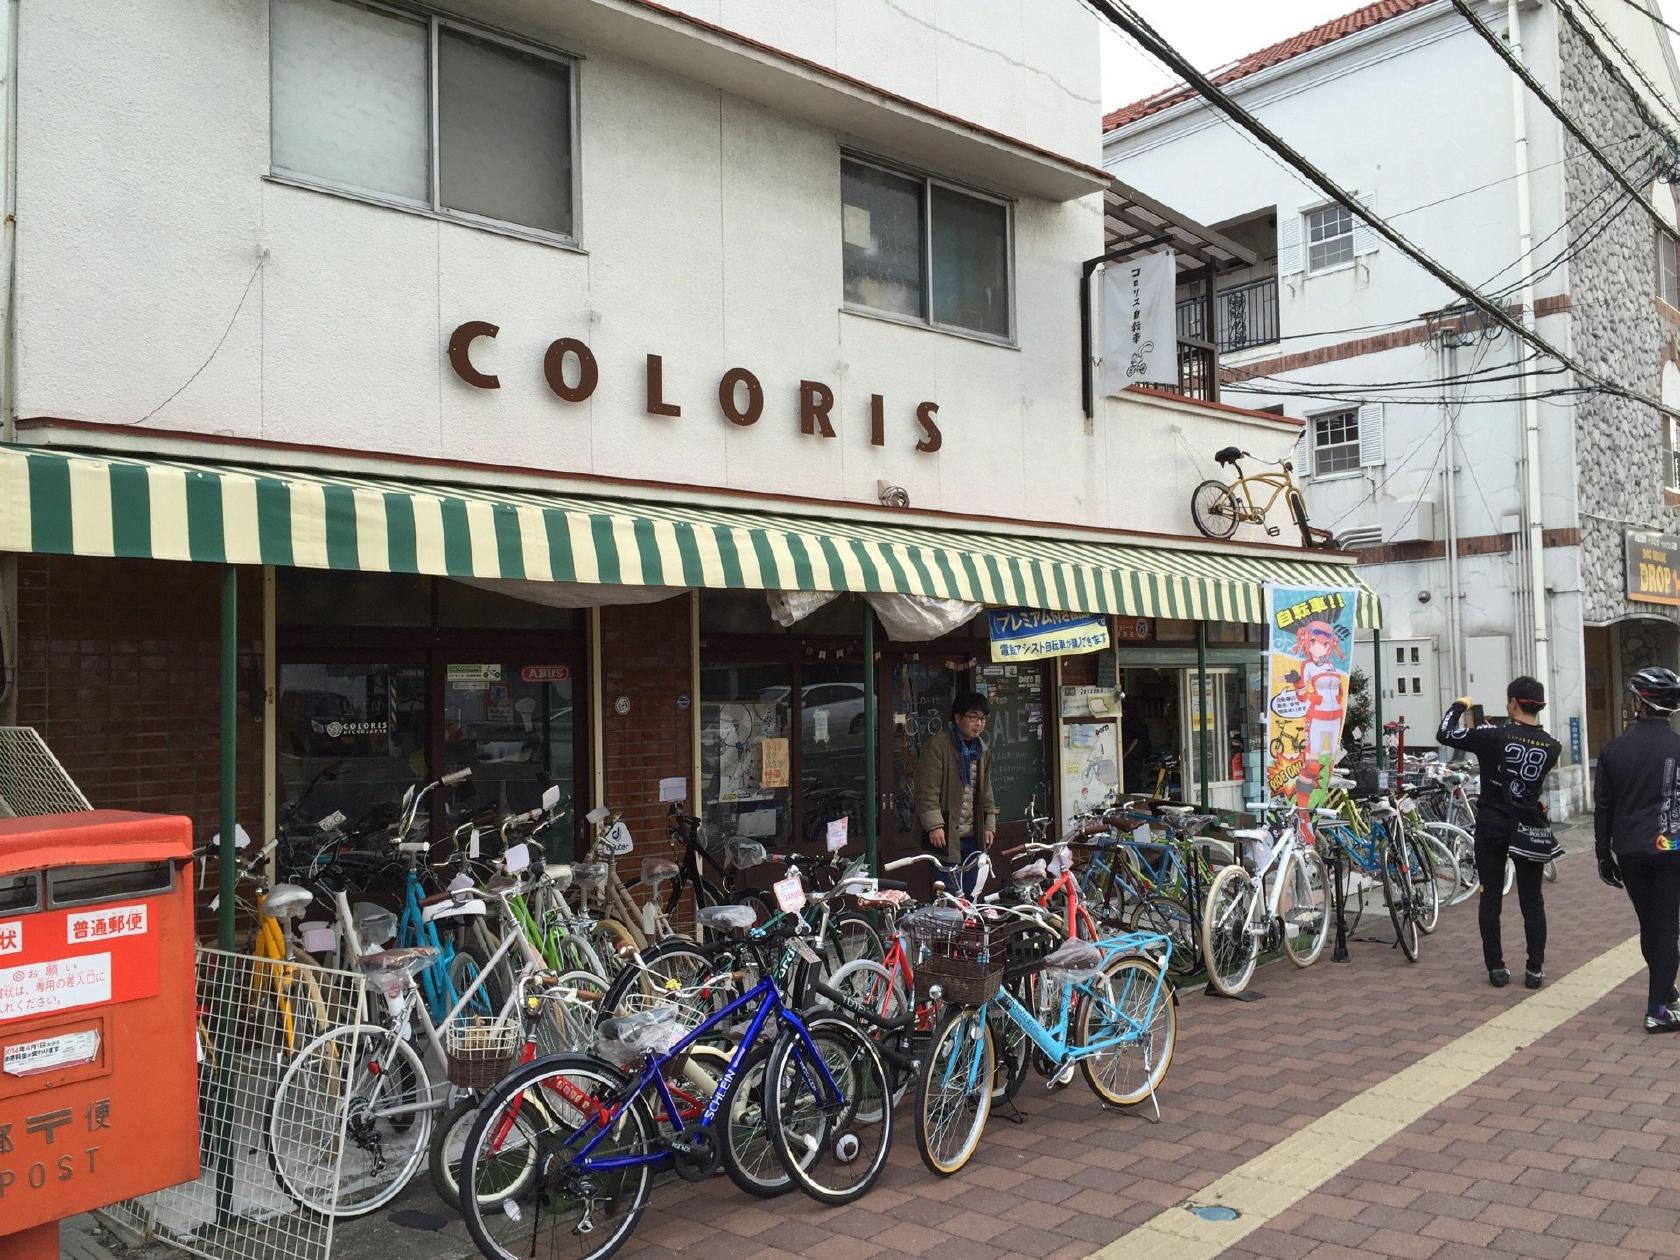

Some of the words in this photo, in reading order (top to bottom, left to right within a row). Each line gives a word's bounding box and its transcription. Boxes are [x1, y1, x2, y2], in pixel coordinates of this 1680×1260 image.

[1131, 267, 1141, 345] コロリス自転車
[448, 320, 943, 453] COLORIS
[1639, 562, 1671, 594] DROP
[1000, 633, 1107, 657] 電動アシスト自転車が購入できます
[528, 668, 564, 679] ABUS
[343, 722, 387, 730] COLORIS
[1502, 743, 1548, 781] 28
[1269, 770, 1287, 791] RIDE
[73, 912, 143, 940] 普通郵便
[0, 972, 105, 999] 状は、専用の差入口に
[703, 1069, 736, 1120] SCHLEIN
[0, 1146, 99, 1198] POST
